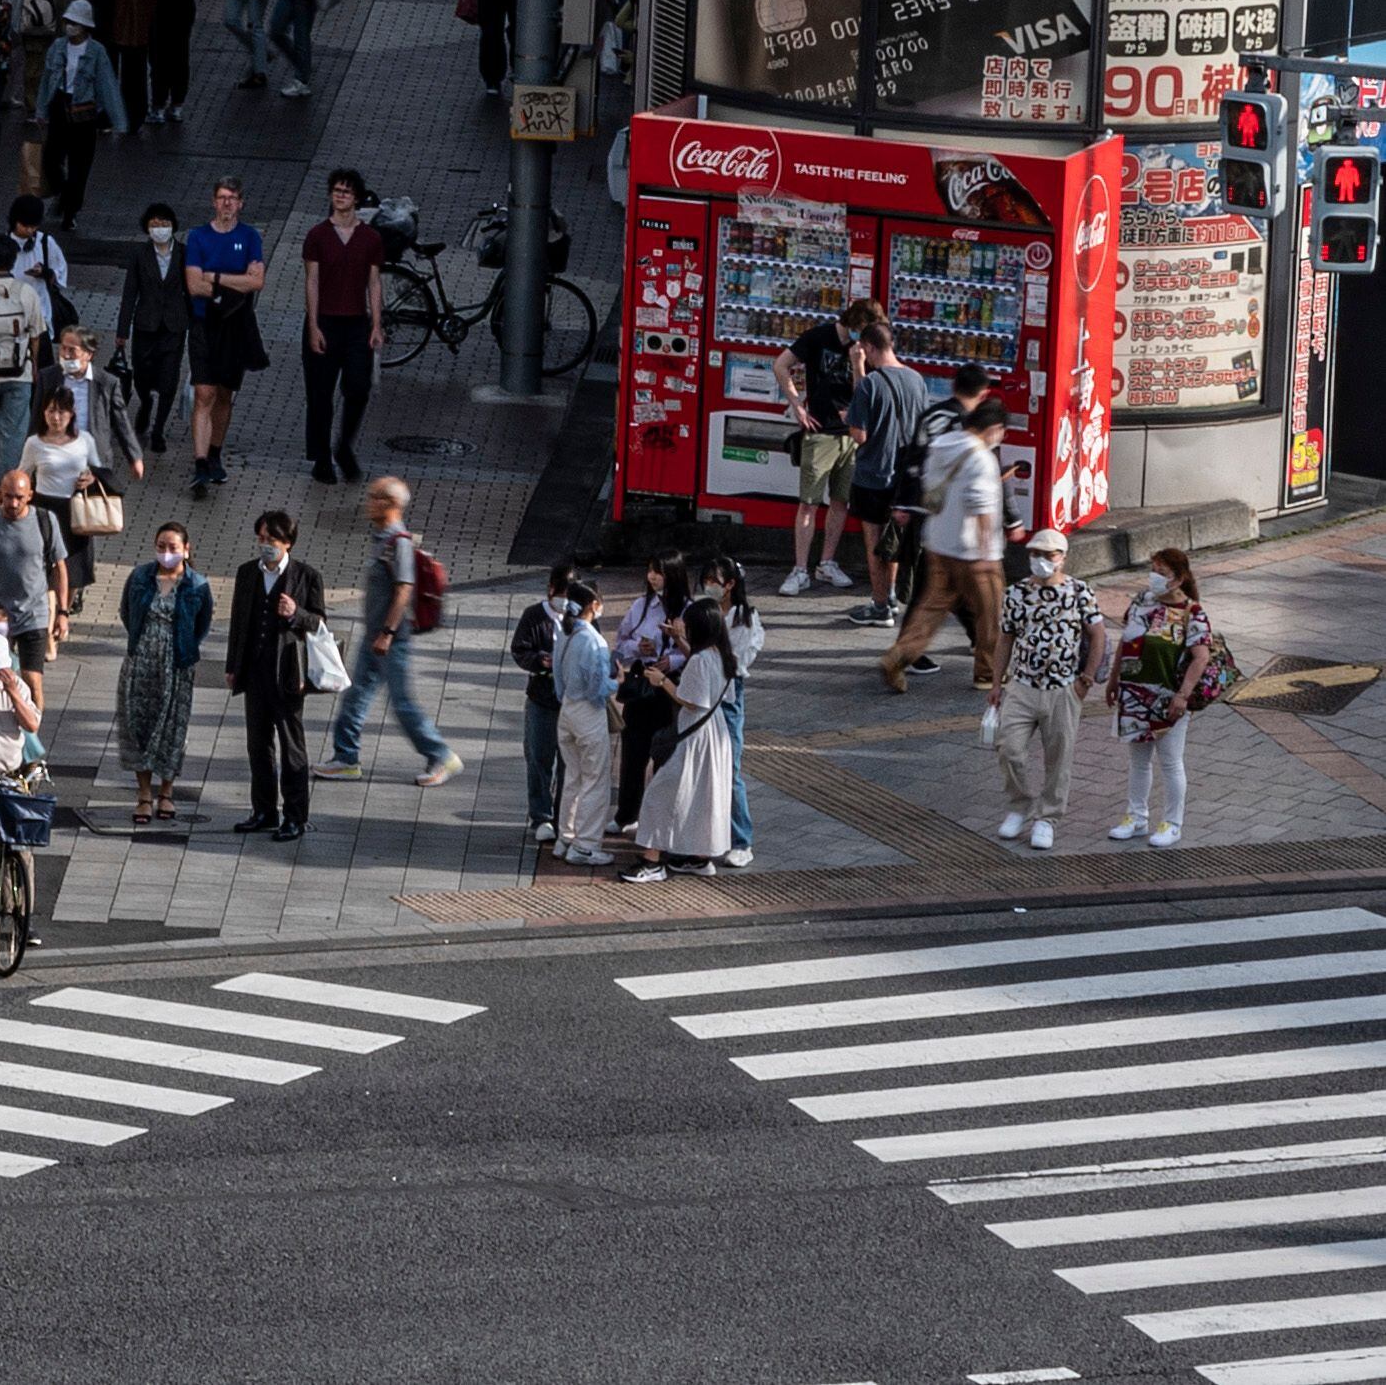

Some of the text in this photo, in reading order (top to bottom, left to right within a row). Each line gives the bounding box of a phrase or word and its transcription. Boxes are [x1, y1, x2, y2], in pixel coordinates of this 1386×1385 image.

[993, 12, 1082, 56] VISA
[1107, 8, 1277, 43] 盗難 破損 水没
[763, 26, 817, 58] 4980
[1124, 37, 1264, 55] から から から
[983, 55, 1053, 78] 店内で
[982, 77, 1073, 101] 即時発行
[1104, 65, 1184, 118] 90
[981, 100, 1085, 123] 致します!
[676, 140, 776, 181] Coca-Cola
[793, 162, 907, 186] TASTE THE FEELING
[1119, 209, 1184, 227] ちらから、
[1118, 222, 1250, 245] 徒町方面に約110m
[1129, 356, 1208, 375] スマートフォン
